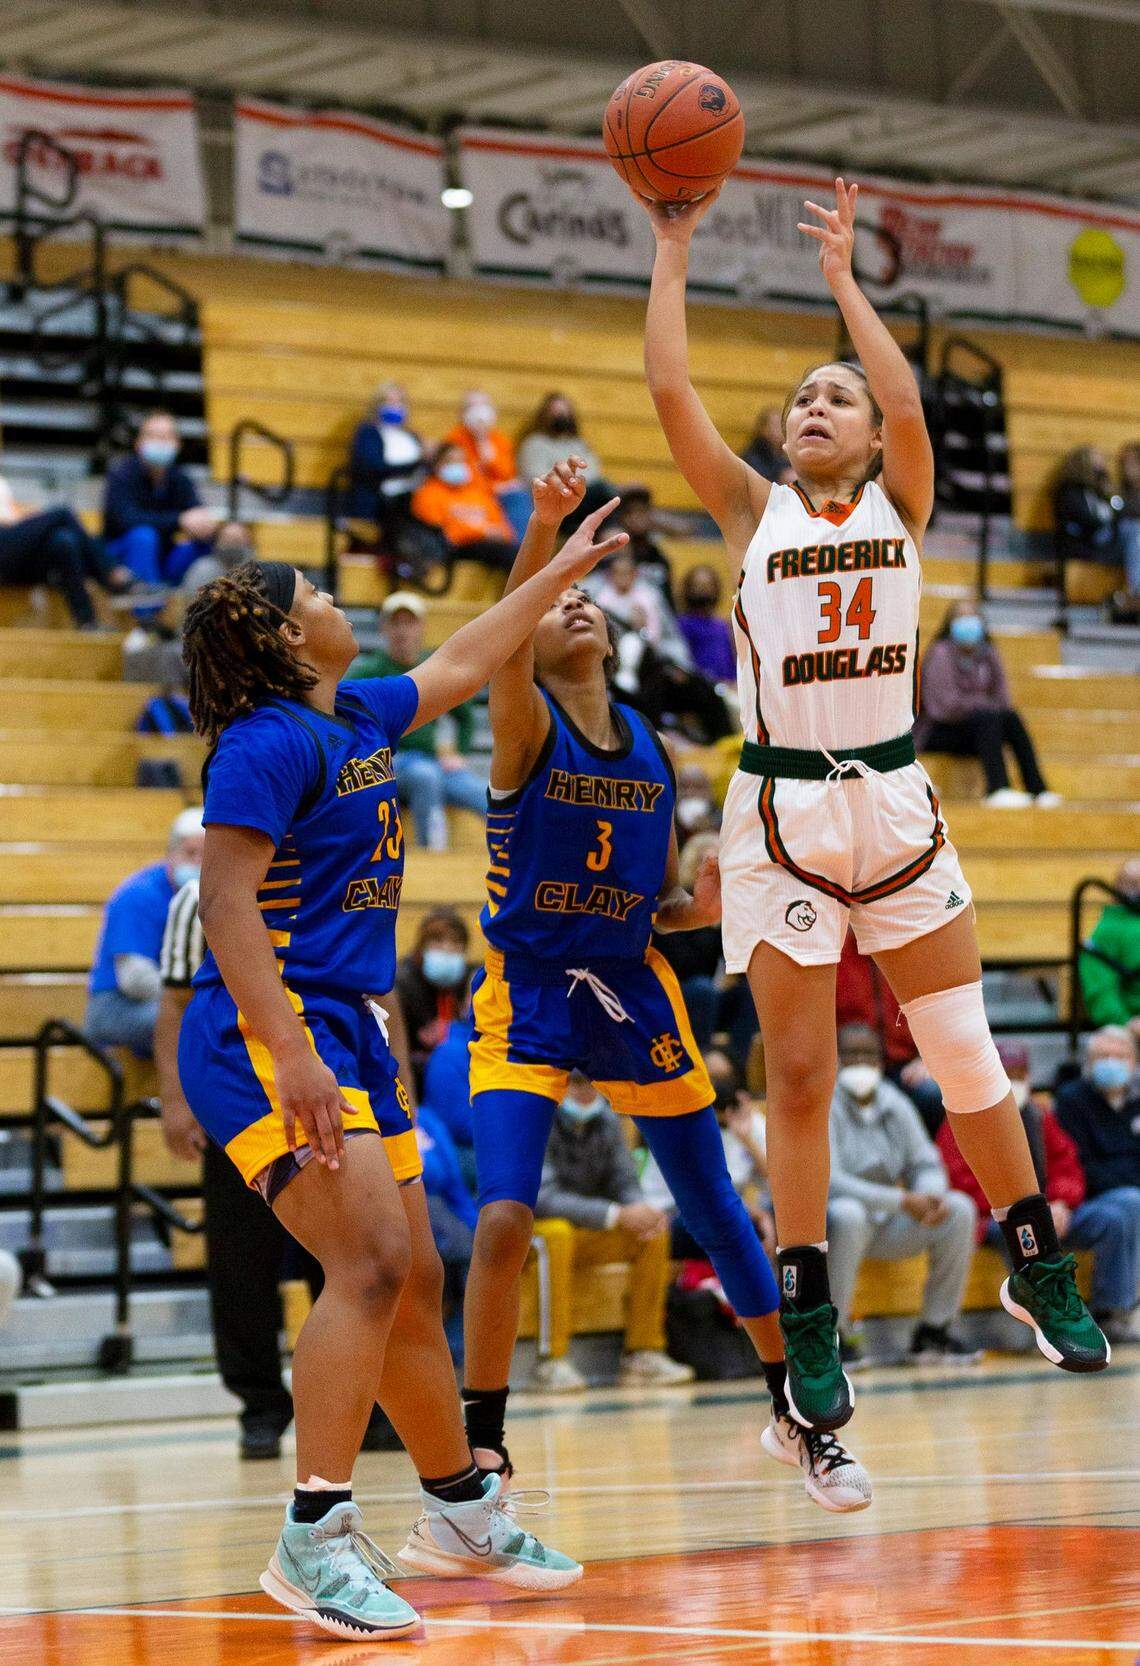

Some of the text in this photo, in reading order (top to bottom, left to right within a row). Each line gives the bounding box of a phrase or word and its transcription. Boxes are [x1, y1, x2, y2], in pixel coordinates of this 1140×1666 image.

[767, 538, 907, 584] FREDERICK
[817, 577, 877, 644] 34
[782, 643, 908, 687] DOUGLASS
[545, 769, 665, 812] HENRY
[370, 798, 404, 863] 23
[586, 820, 613, 872] 3
[342, 876, 404, 913] CLAY
[534, 881, 645, 921] CLAY
